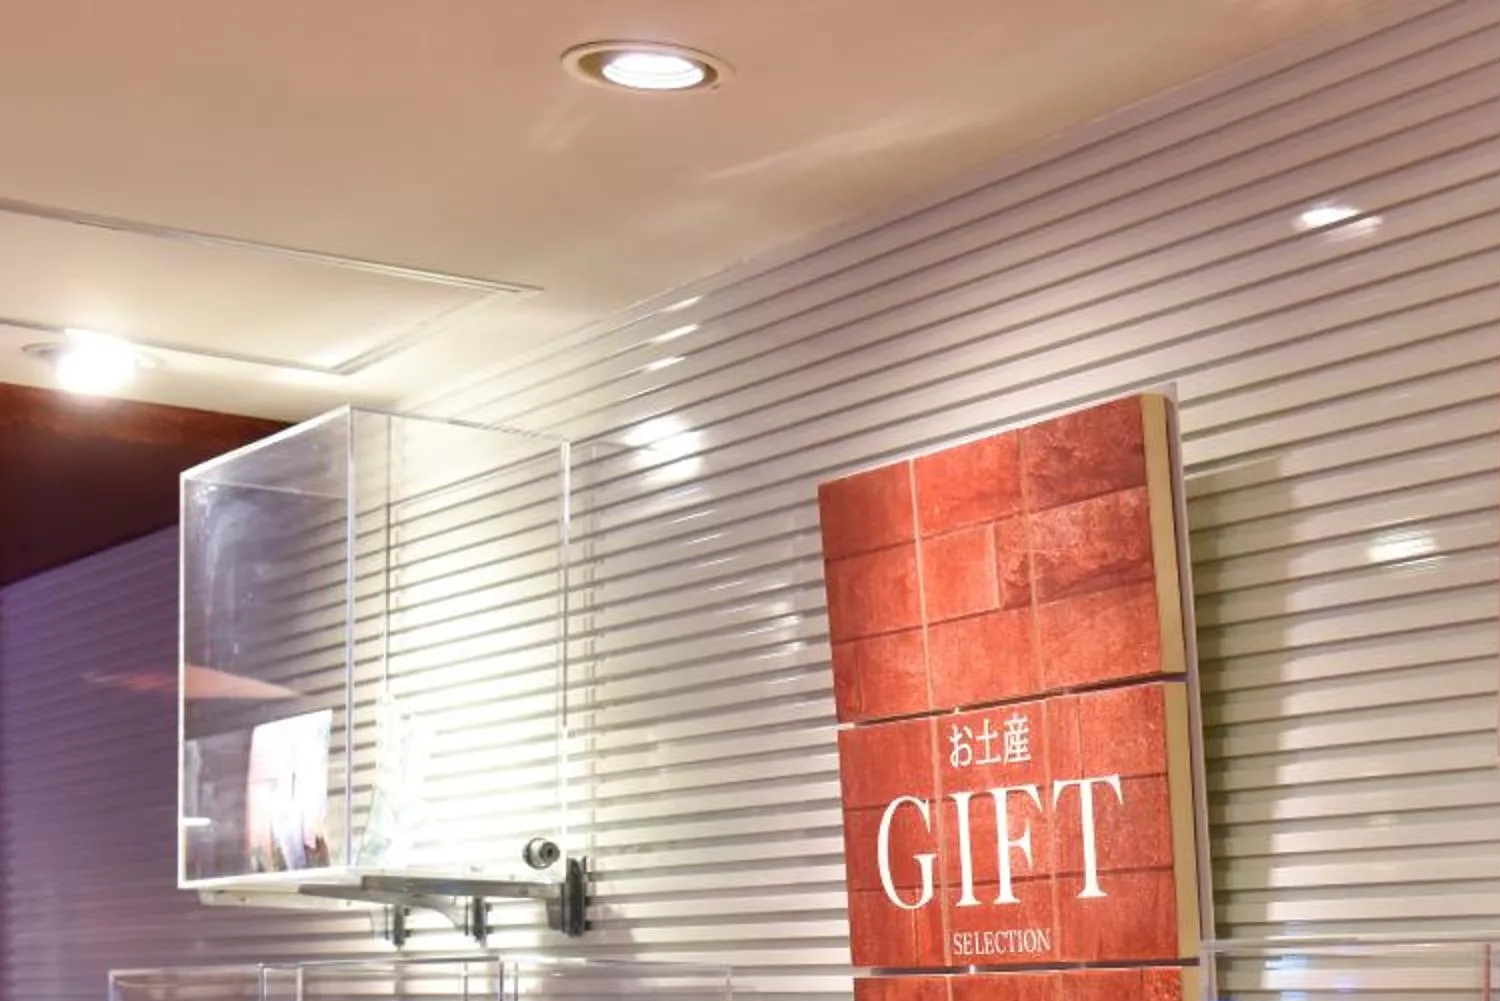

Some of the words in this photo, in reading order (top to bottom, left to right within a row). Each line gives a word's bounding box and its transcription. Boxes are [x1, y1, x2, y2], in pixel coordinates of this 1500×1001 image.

[948, 712, 1032, 768] お土産
[876, 773, 1124, 910] GIFT
[952, 927, 1052, 956] SELECTION
